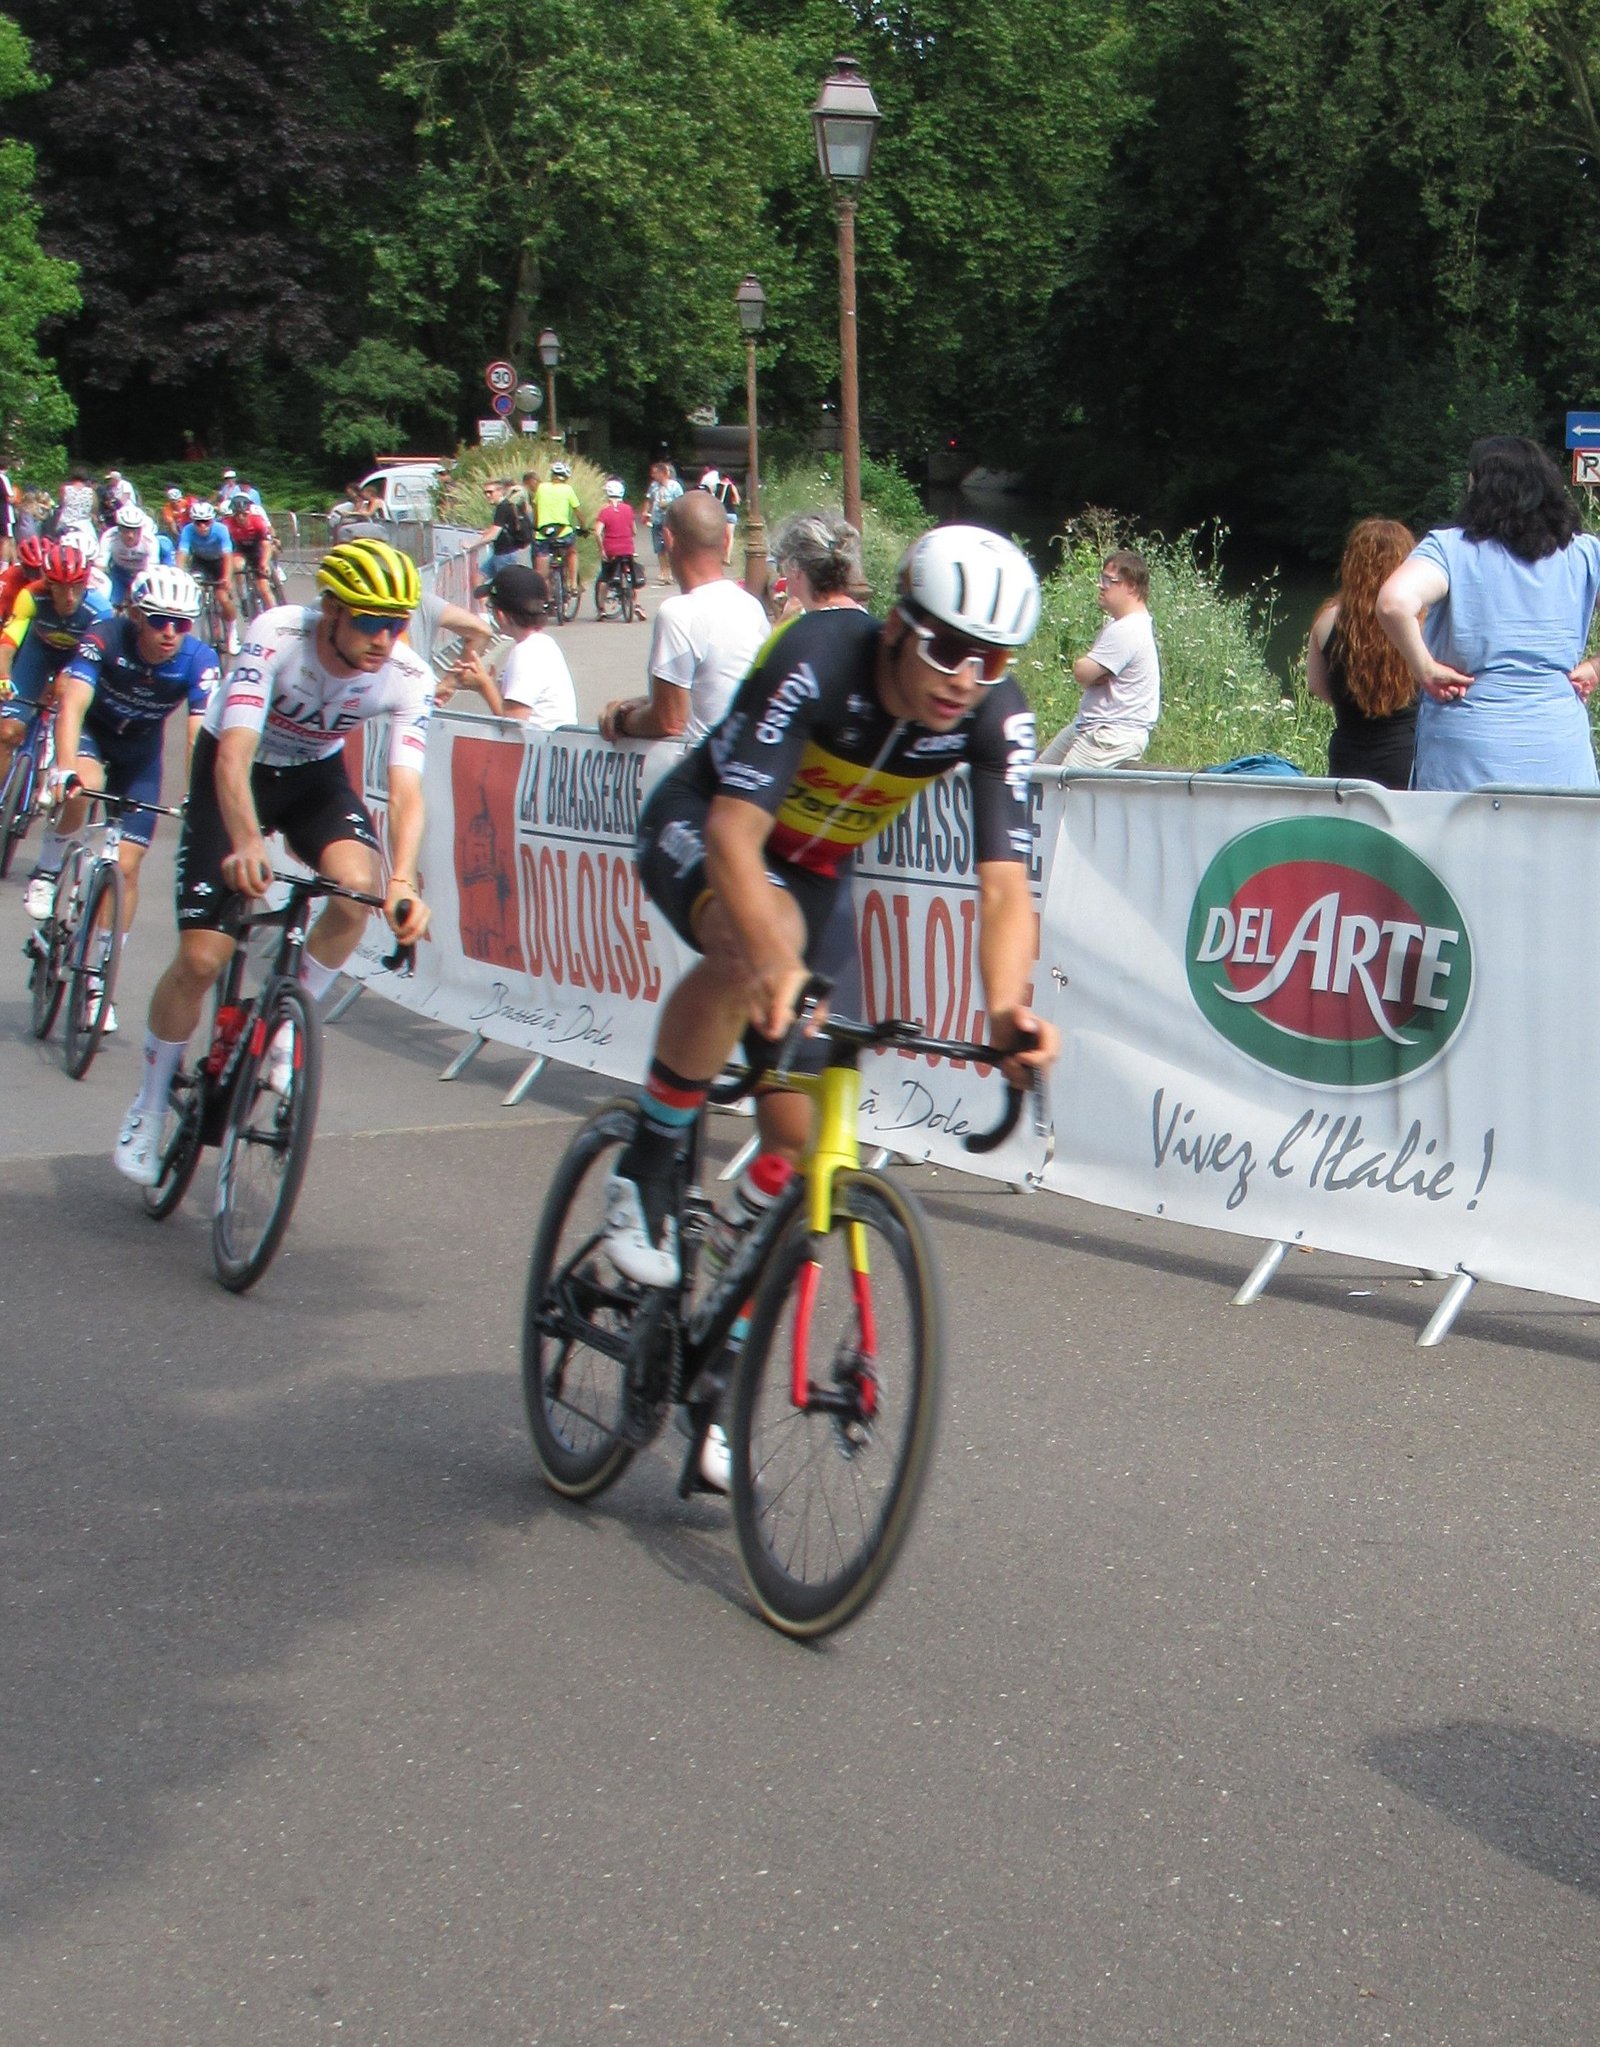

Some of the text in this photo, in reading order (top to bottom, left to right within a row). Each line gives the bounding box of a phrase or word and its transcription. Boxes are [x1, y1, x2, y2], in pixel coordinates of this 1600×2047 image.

[491, 371, 510, 385] 30
[272, 694, 363, 732] UAE
[520, 743, 646, 836] LA BRASSERIE
[877, 773, 1043, 883] BRASSE
[519, 843, 662, 1004] DOLOISE
[1196, 892, 1460, 1046] DEL ARTE
[548, 1004, 613, 1046] Dole
[858, 1080, 970, 1136] à Dole
[1153, 1088, 1495, 1211] Vivez l'Italie !
